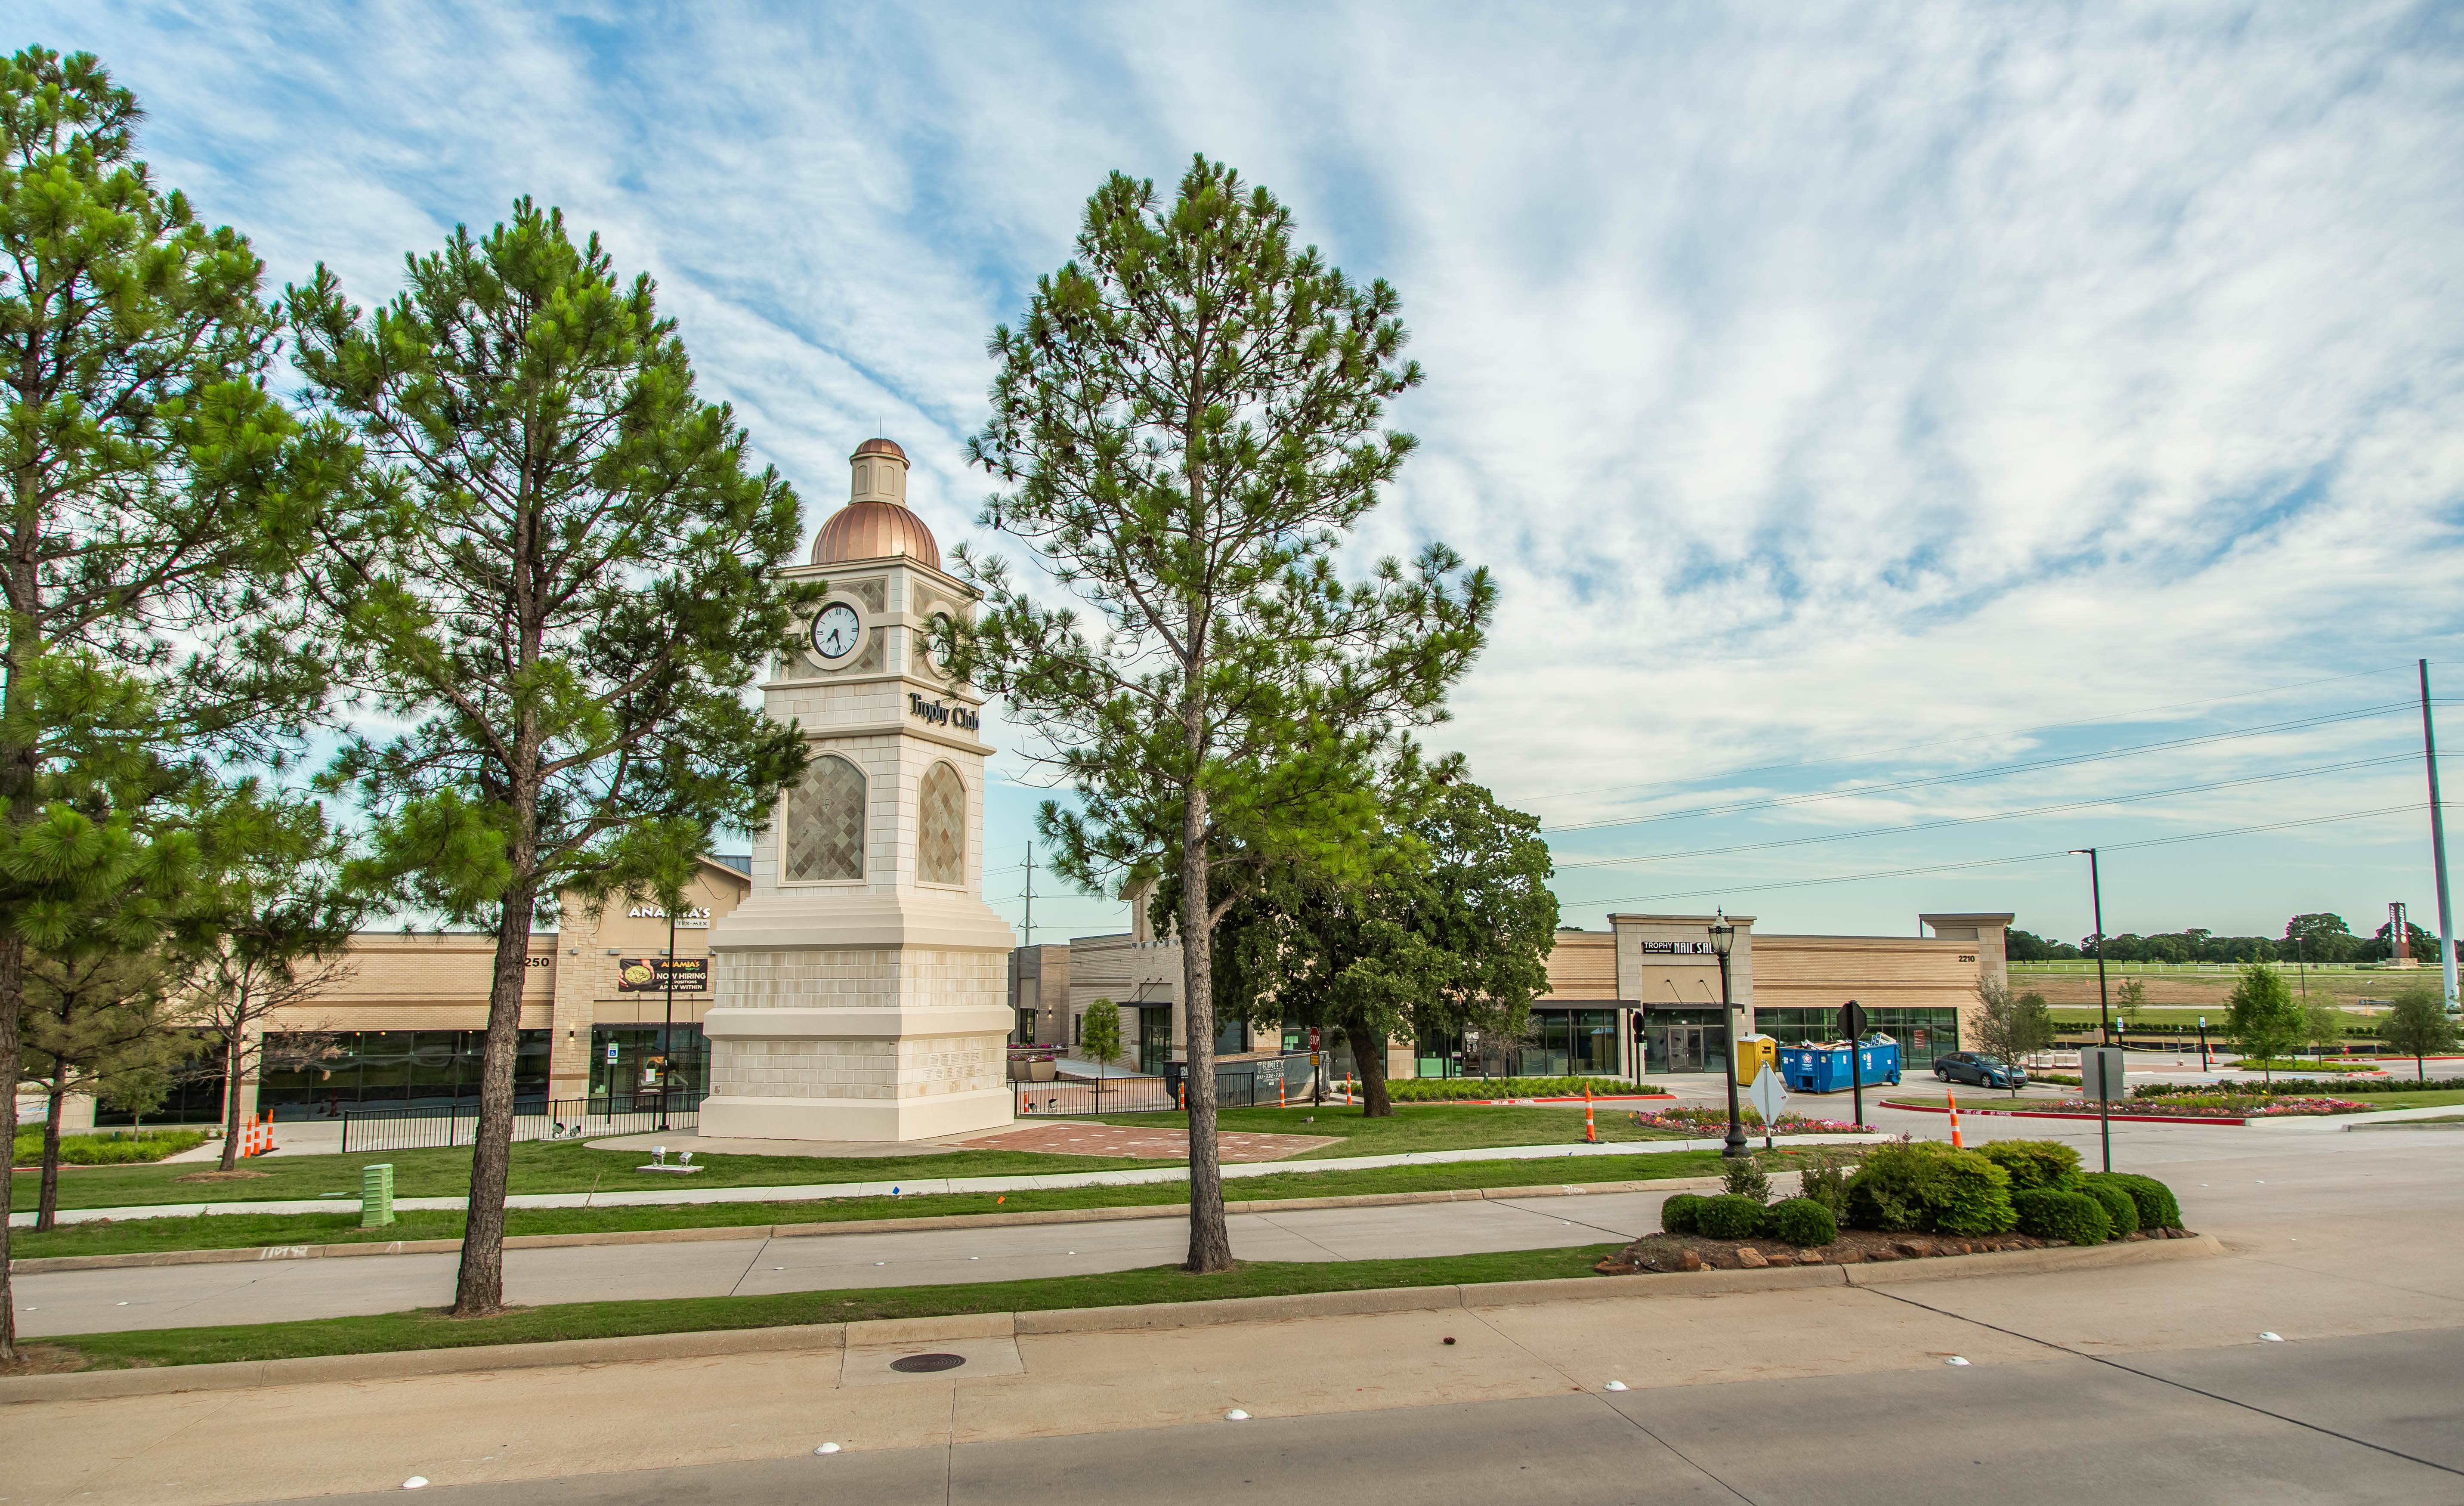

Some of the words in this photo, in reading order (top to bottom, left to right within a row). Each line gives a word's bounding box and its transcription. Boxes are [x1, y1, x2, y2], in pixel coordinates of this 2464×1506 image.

[909, 693, 950, 726] Trophy
[951, 707, 980, 730] Club
[1674, 943, 1696, 954] NAIL
[1697, 943, 1715, 954] SAL
[524, 958, 549, 967] 250
[1310, 1035, 1319, 1045] STOP
[1257, 1060, 1285, 1074] TRINITY
